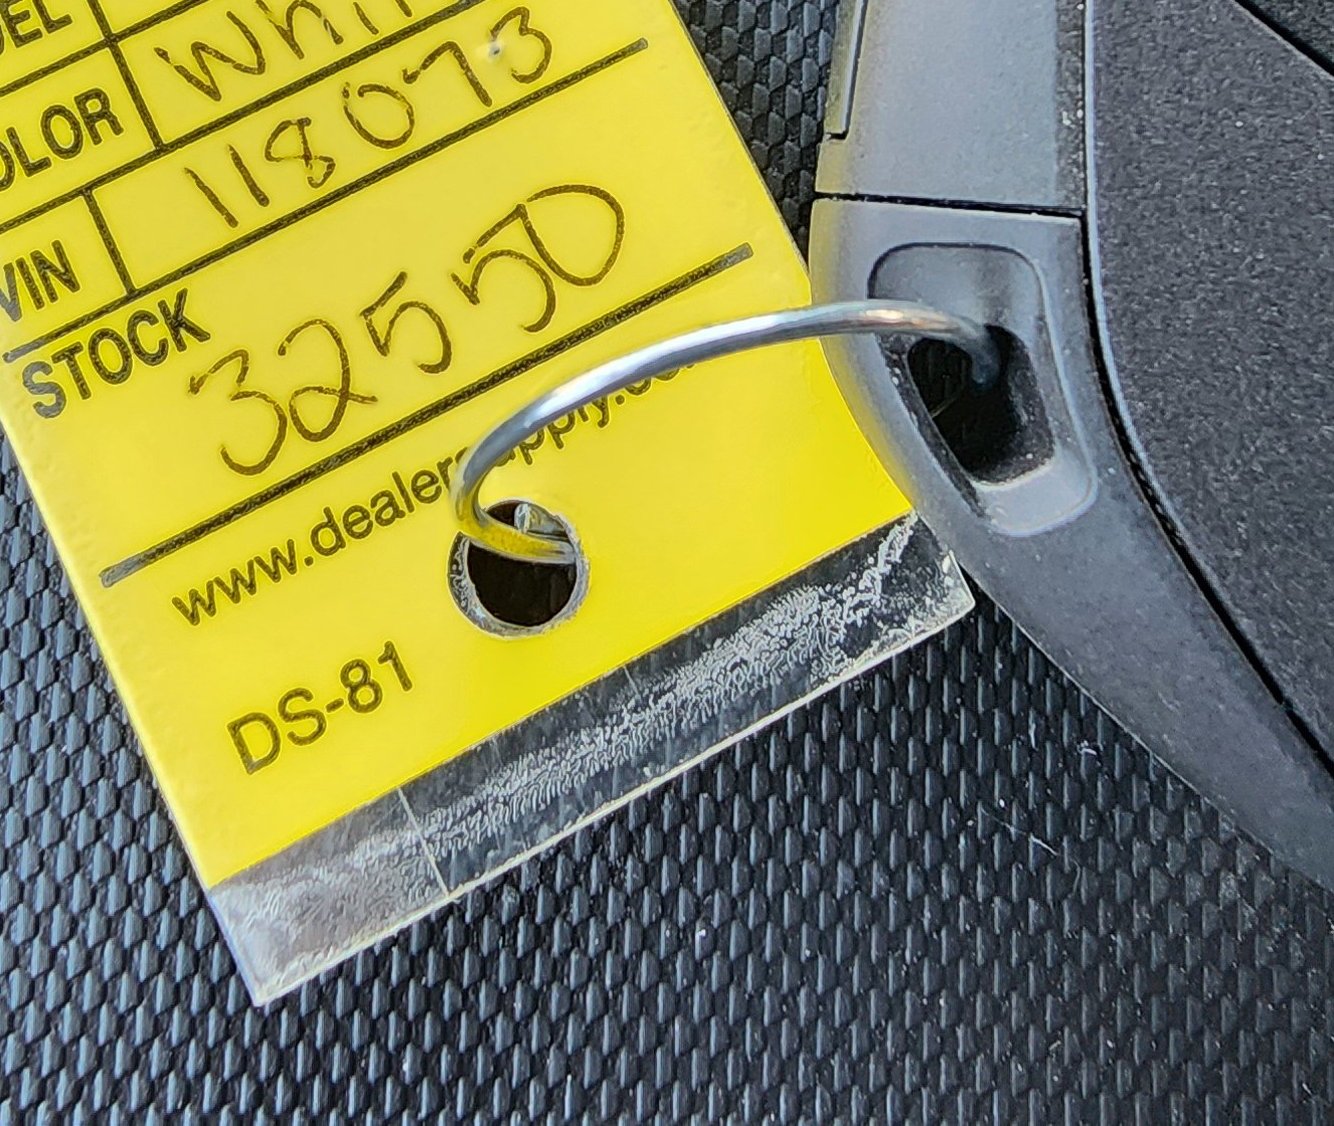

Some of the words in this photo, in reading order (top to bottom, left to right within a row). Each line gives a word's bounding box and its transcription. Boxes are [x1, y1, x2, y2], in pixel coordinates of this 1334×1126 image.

[184, 6, 554, 228] 118073
[23, 288, 211, 419] STOCK
[189, 183, 626, 475] 32550
[228, 640, 416, 775] DS-81
